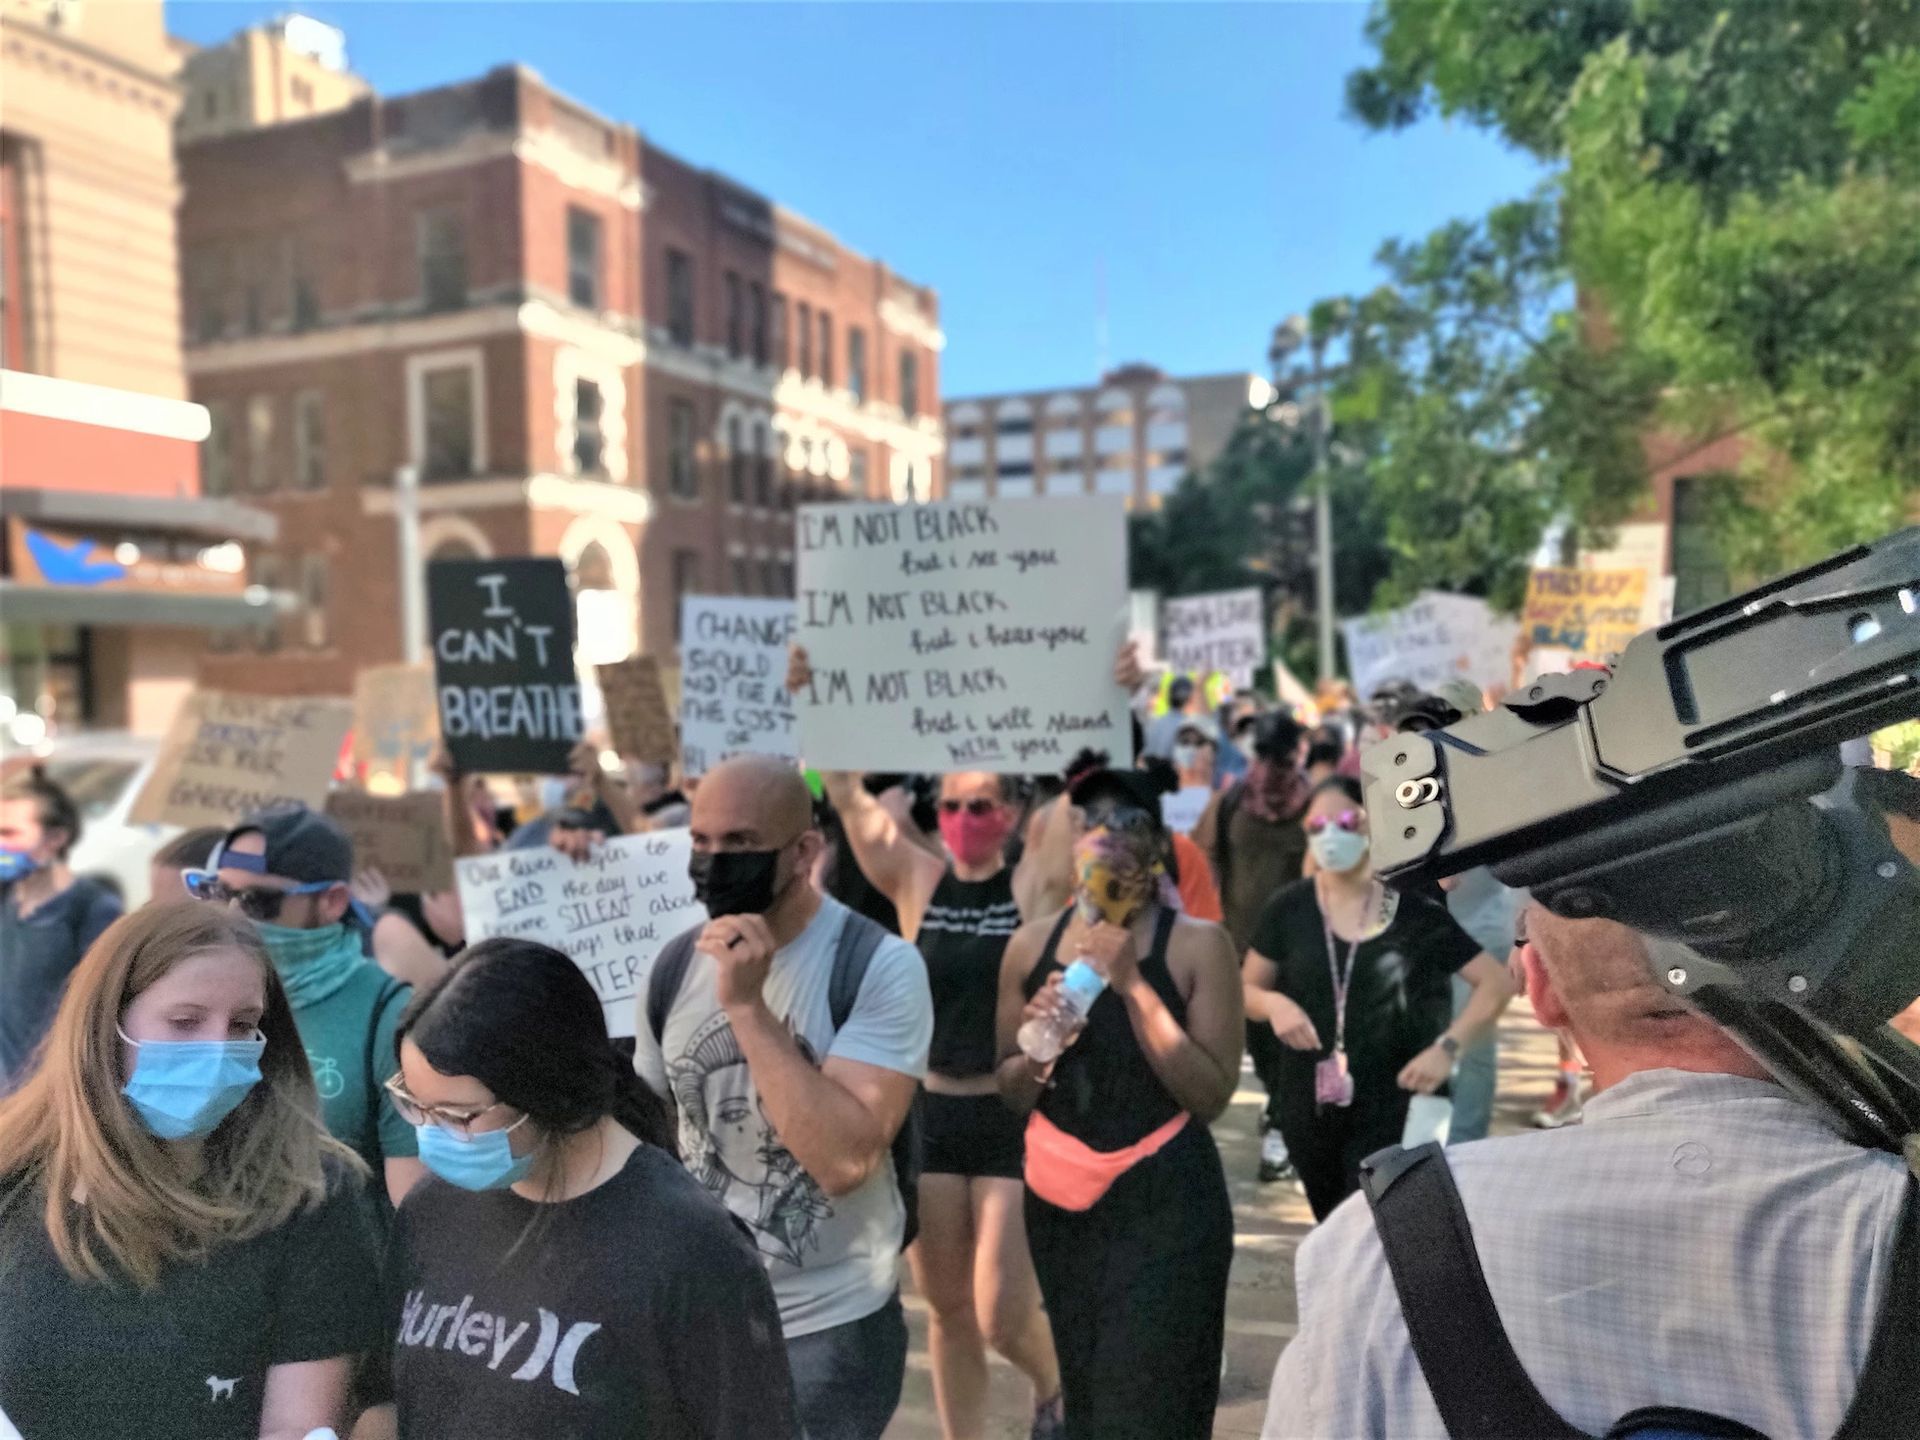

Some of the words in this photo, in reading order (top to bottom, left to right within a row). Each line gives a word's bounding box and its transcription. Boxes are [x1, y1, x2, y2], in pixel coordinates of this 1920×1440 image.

[802, 512, 843, 550] I'M
[853, 511, 903, 546] NOT
[913, 505, 998, 543] BLACK
[900, 549, 943, 576] but
[967, 550, 999, 569] see
[1006, 549, 1059, 575] you
[473, 573, 515, 617] I
[803, 590, 853, 628] I'M
[867, 590, 911, 625] NOT
[920, 589, 1009, 618] BLACK
[438, 615, 554, 668] CAN'T
[910, 626, 957, 655] but
[1036, 625, 1090, 652] you
[807, 667, 854, 706] I'M
[866, 668, 912, 705] NOT
[923, 665, 1008, 698] BLACK
[440, 683, 585, 740] BREATHE
[733, 707, 798, 735] COST
[911, 706, 959, 736] but
[987, 705, 1034, 731] will
[1045, 708, 1114, 735] stand
[1011, 737, 1063, 762] you
[645, 839, 671, 857] to
[493, 881, 545, 916] END
[561, 877, 592, 899] the
[596, 875, 627, 898] day
[637, 869, 669, 889] we
[557, 893, 634, 931] SILENT
[613, 921, 661, 945] that
